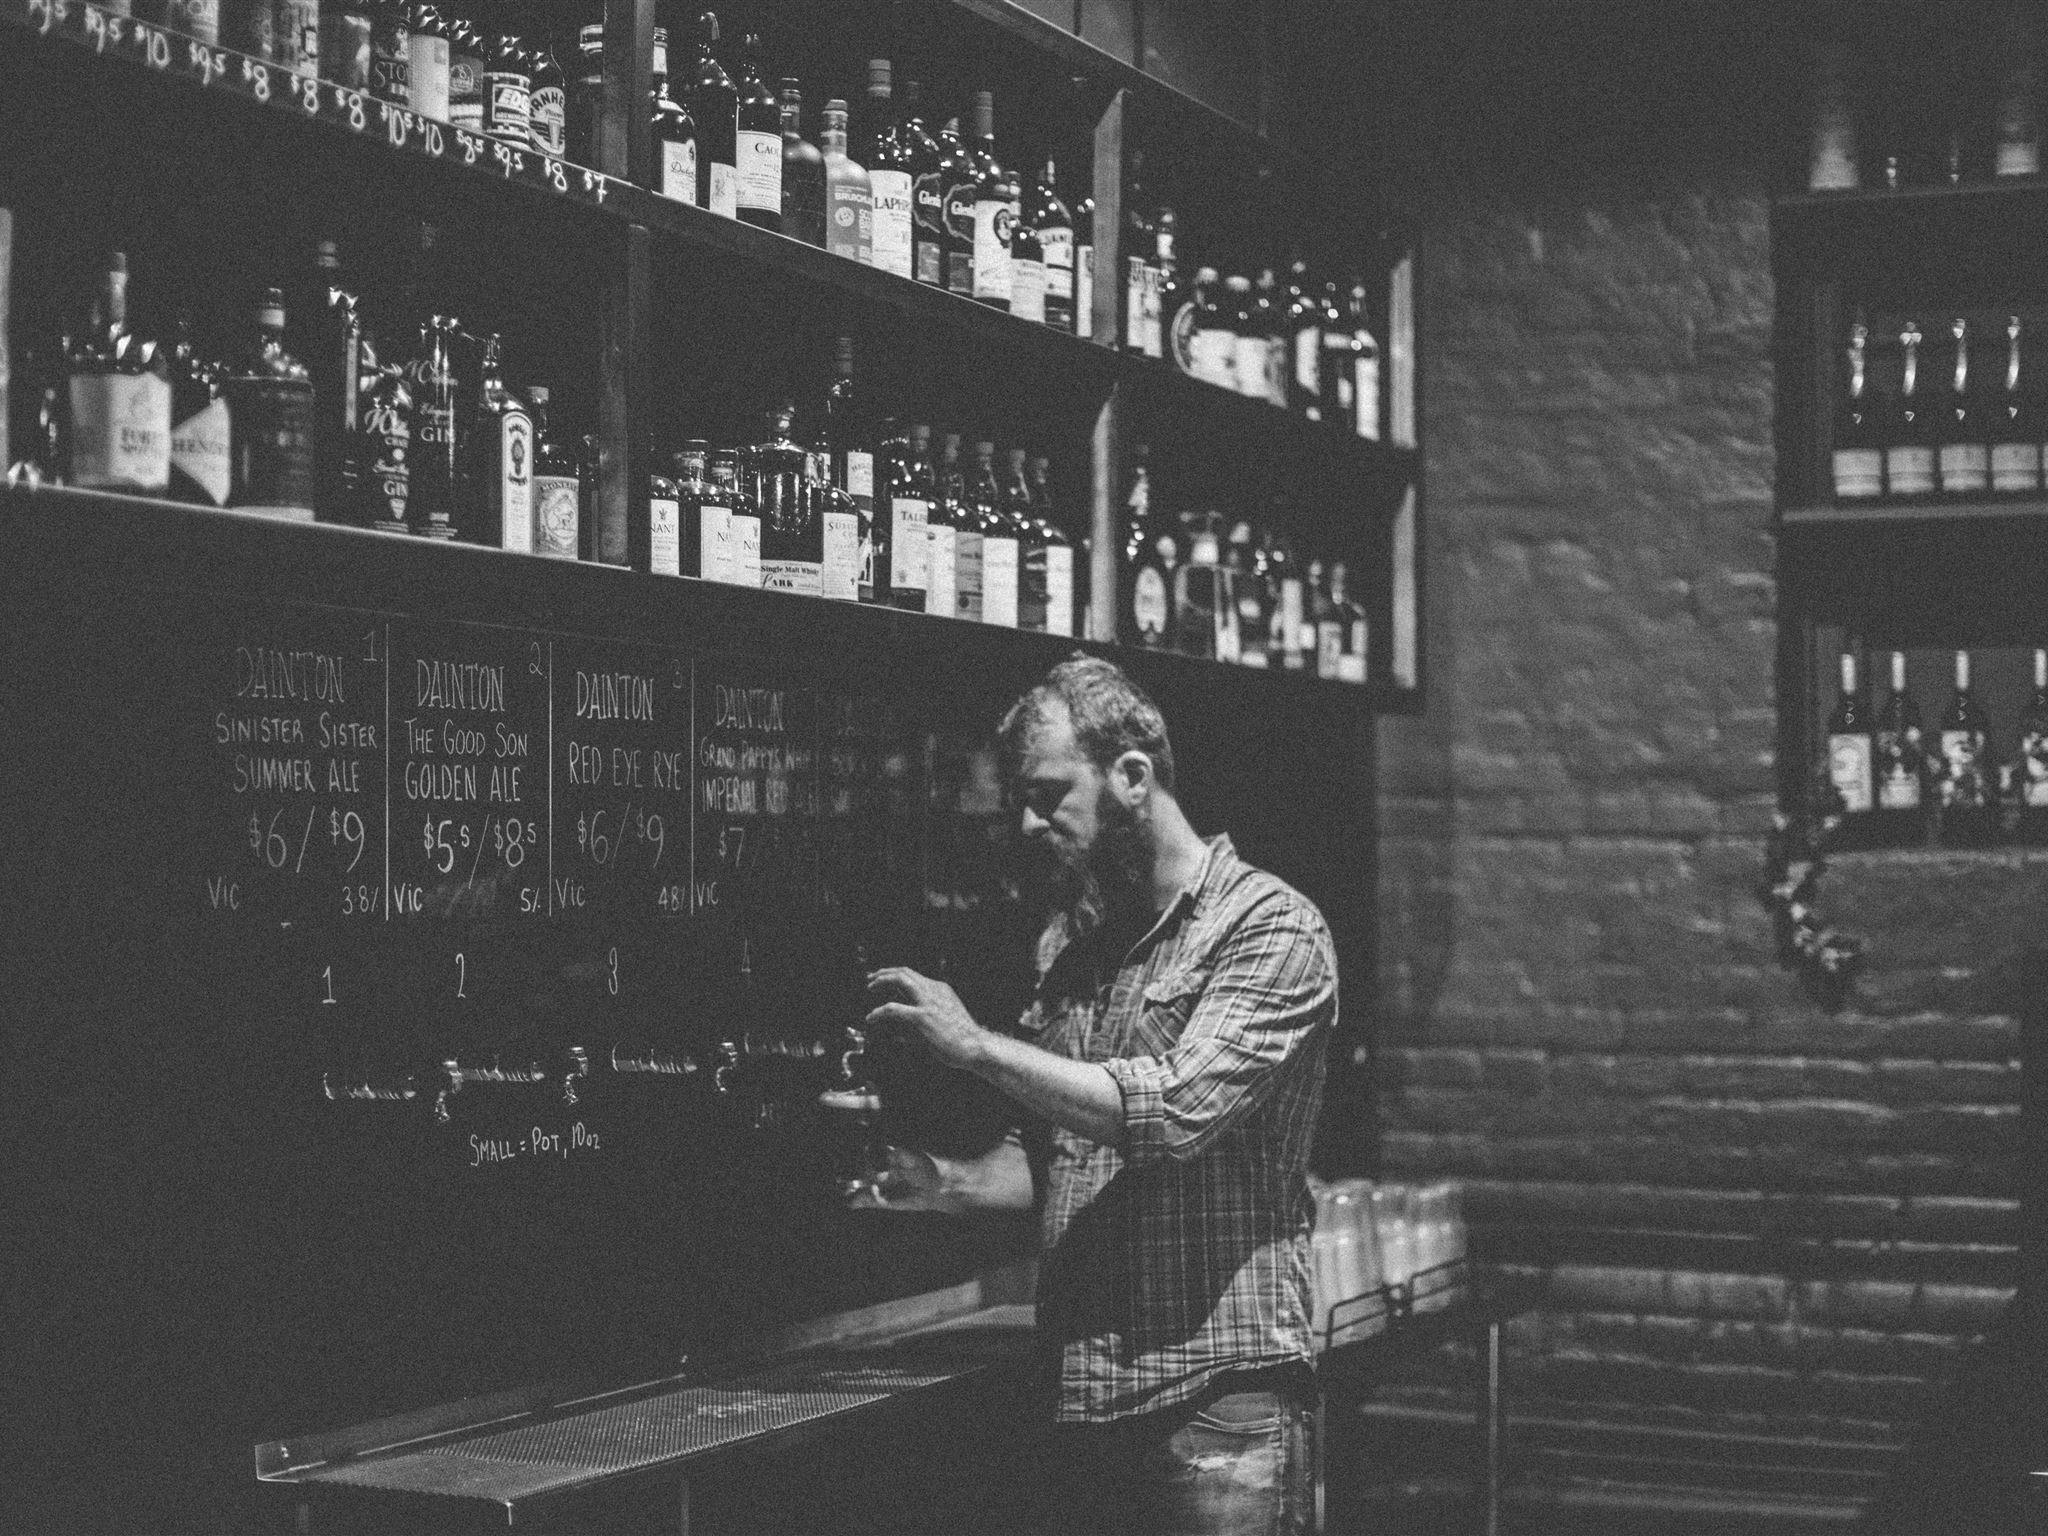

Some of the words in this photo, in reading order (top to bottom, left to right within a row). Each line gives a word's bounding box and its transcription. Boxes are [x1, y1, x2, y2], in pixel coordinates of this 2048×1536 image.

[373, 61, 407, 88] STO
[335, 88, 366, 131] $8
[421, 427, 456, 443] GIN
[383, 479, 408, 497] GIN
[235, 646, 345, 703] DAINTON
[417, 659, 506, 712] DAINTON
[576, 670, 655, 721] DAINTON
[215, 712, 304, 744] SINISTER
[319, 711, 378, 749] SISTER
[404, 717, 435, 755] THE
[443, 718, 486, 757] GOOD
[494, 721, 528, 758] SON
[233, 753, 317, 793] SUMMER
[328, 758, 360, 793] ALE
[404, 761, 477, 801] GOLDEN
[489, 765, 522, 802] ALE
[568, 741, 602, 785] RED
[612, 747, 644, 789] EYE
[653, 749, 682, 791] RYE
[322, 964, 337, 1004] 1
[455, 952, 467, 999] 2
[469, 1133, 516, 1168] SMALL
